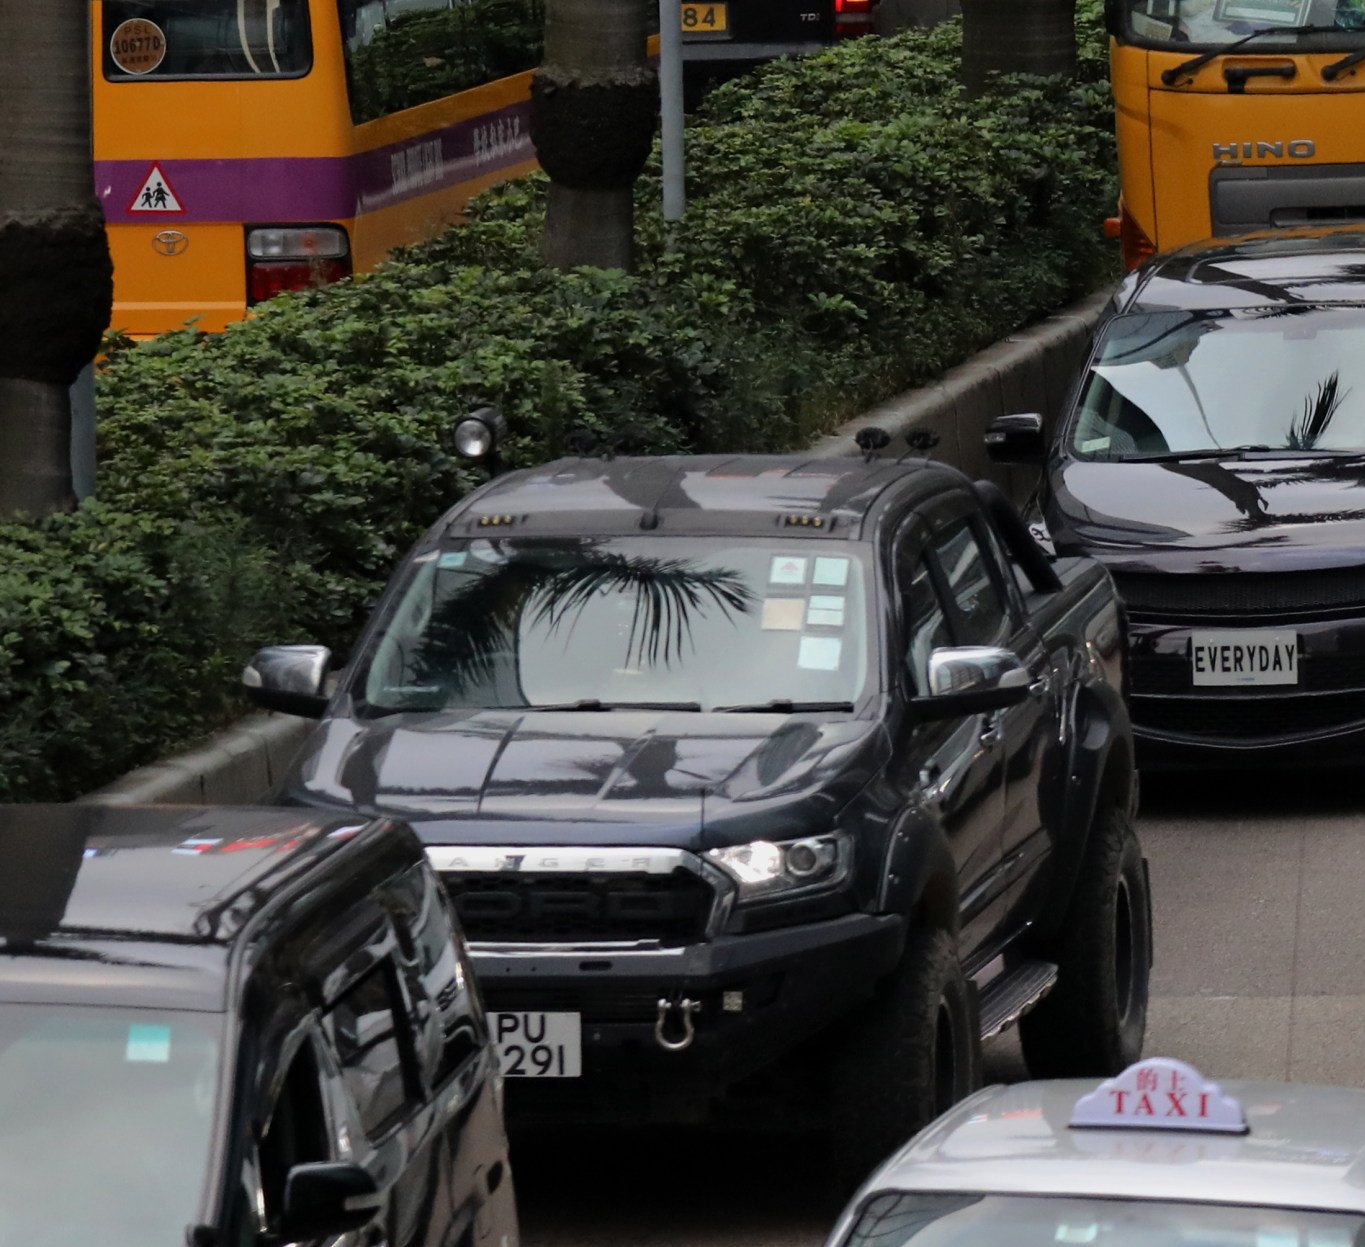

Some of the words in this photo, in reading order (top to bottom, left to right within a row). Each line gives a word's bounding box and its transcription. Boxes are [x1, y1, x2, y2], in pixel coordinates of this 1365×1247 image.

[124, 24, 150, 36] PSL
[1215, 139, 1314, 159] HINO
[1194, 644, 1296, 673] EVERYDAY
[448, 856, 652, 870] ANGER
[498, 1013, 545, 1044] PU
[1109, 1088, 1211, 1118] TAXI
